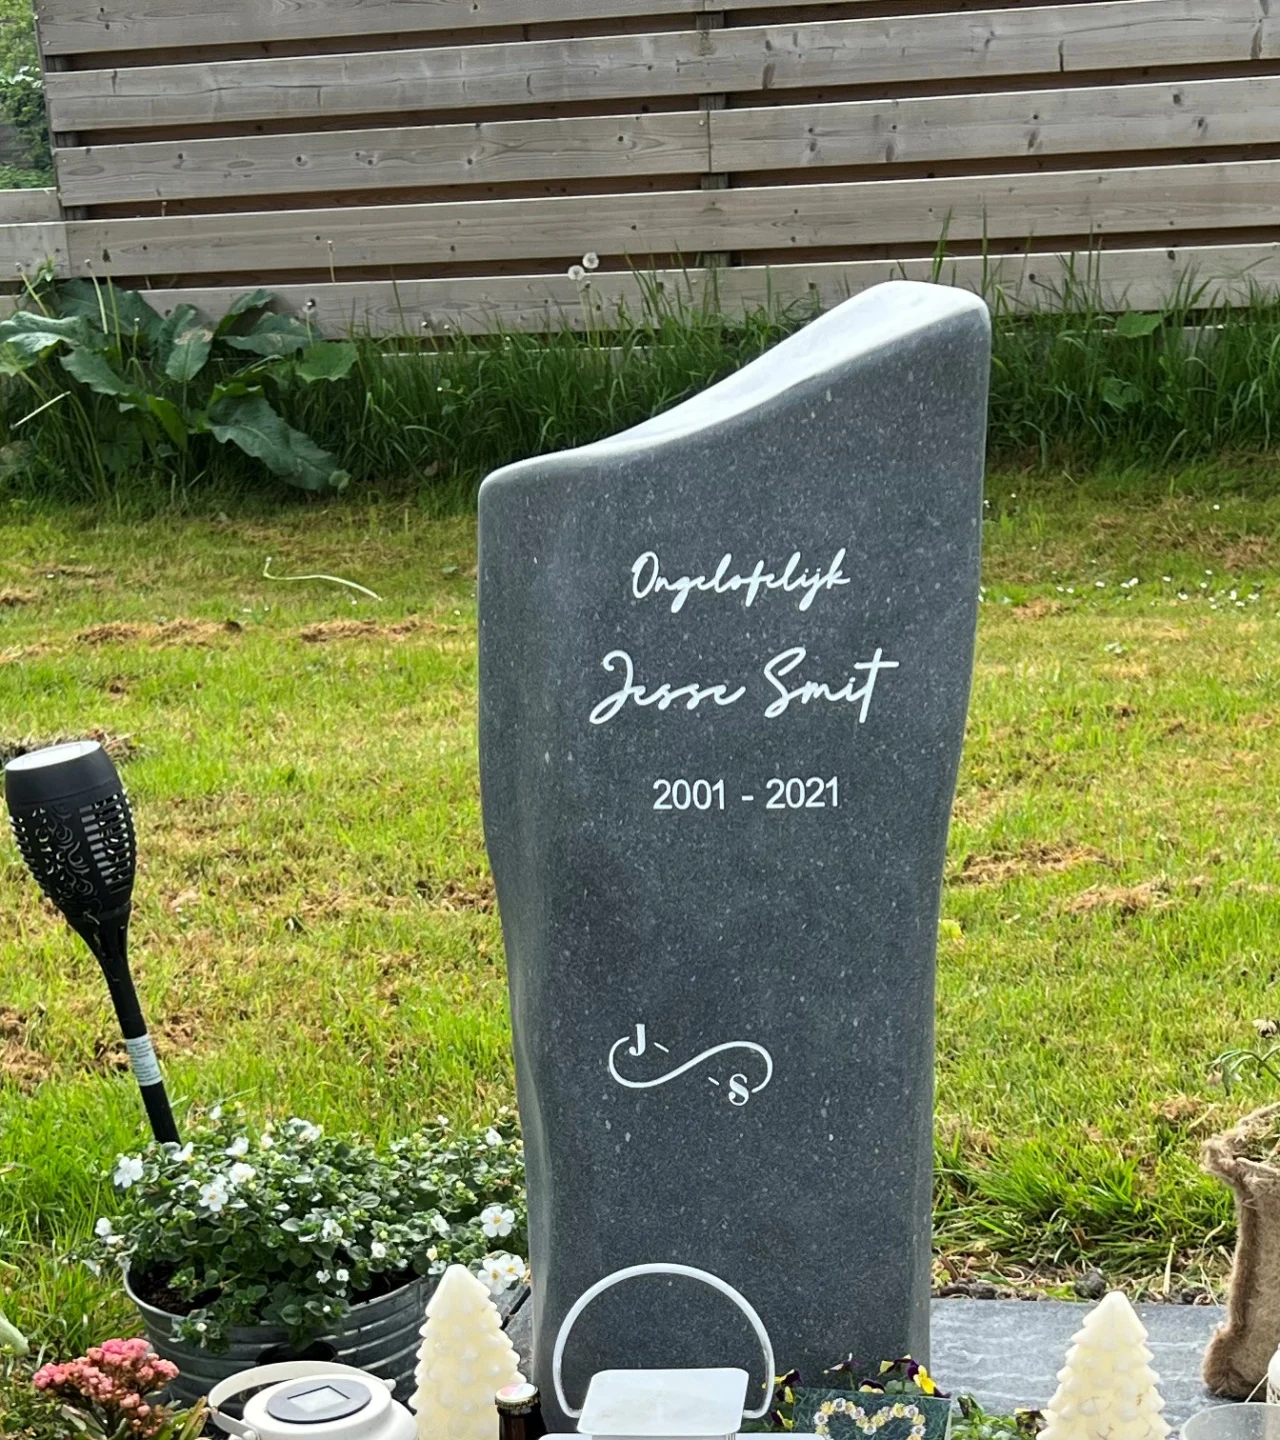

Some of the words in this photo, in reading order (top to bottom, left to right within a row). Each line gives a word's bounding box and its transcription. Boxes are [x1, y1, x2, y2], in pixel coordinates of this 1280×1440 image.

[631, 547, 852, 614] Ongelofelijk
[589, 649, 747, 725] Jesse
[762, 646, 901, 724] Smit
[652, 778, 726, 810] 2001
[765, 776, 839, 809] 2021
[628, 1023, 646, 1057] J
[728, 1073, 750, 1106] S
